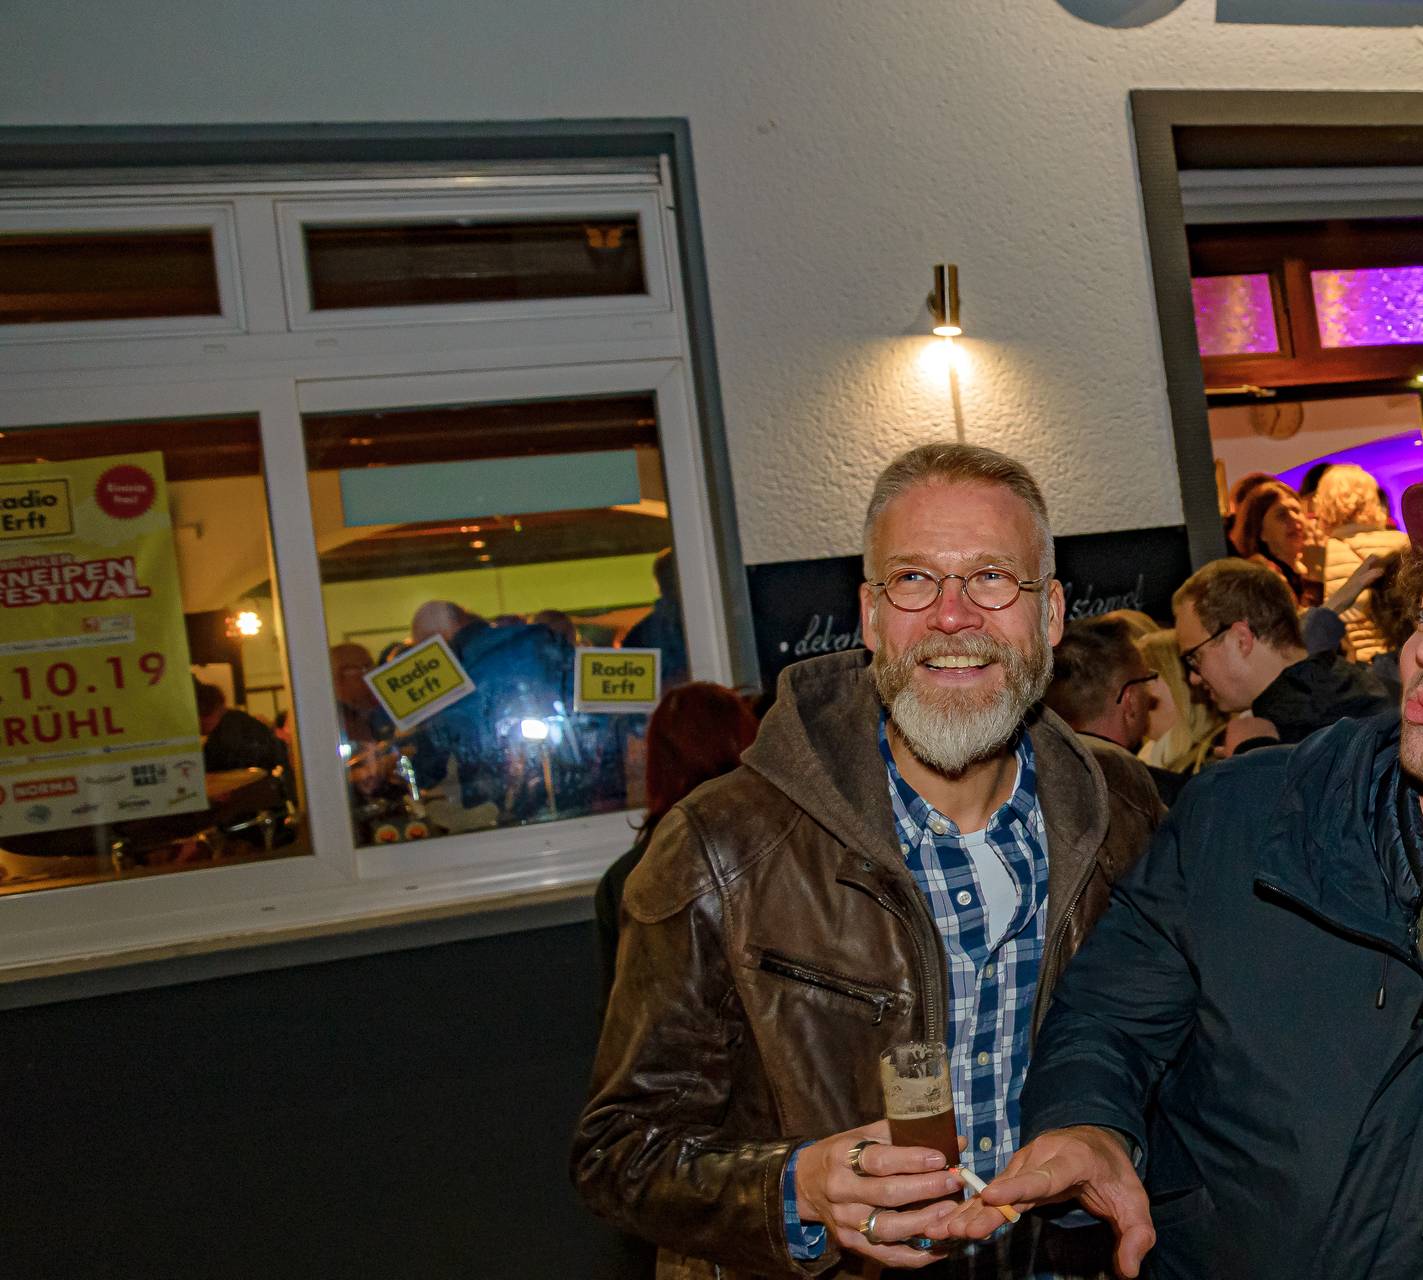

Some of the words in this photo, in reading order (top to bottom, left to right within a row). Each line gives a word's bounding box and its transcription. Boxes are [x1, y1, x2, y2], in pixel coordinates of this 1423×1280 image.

[0, 490, 57, 510] adio
[2, 511, 46, 531] Erft
[0, 578, 149, 605] ESTIVAL
[0, 652, 166, 703] 10.19
[386, 656, 440, 692] Radio
[591, 661, 645, 677] Radio
[407, 676, 442, 702] Erft
[602, 680, 635, 694] Erft
[0, 706, 124, 746] RÜHL
